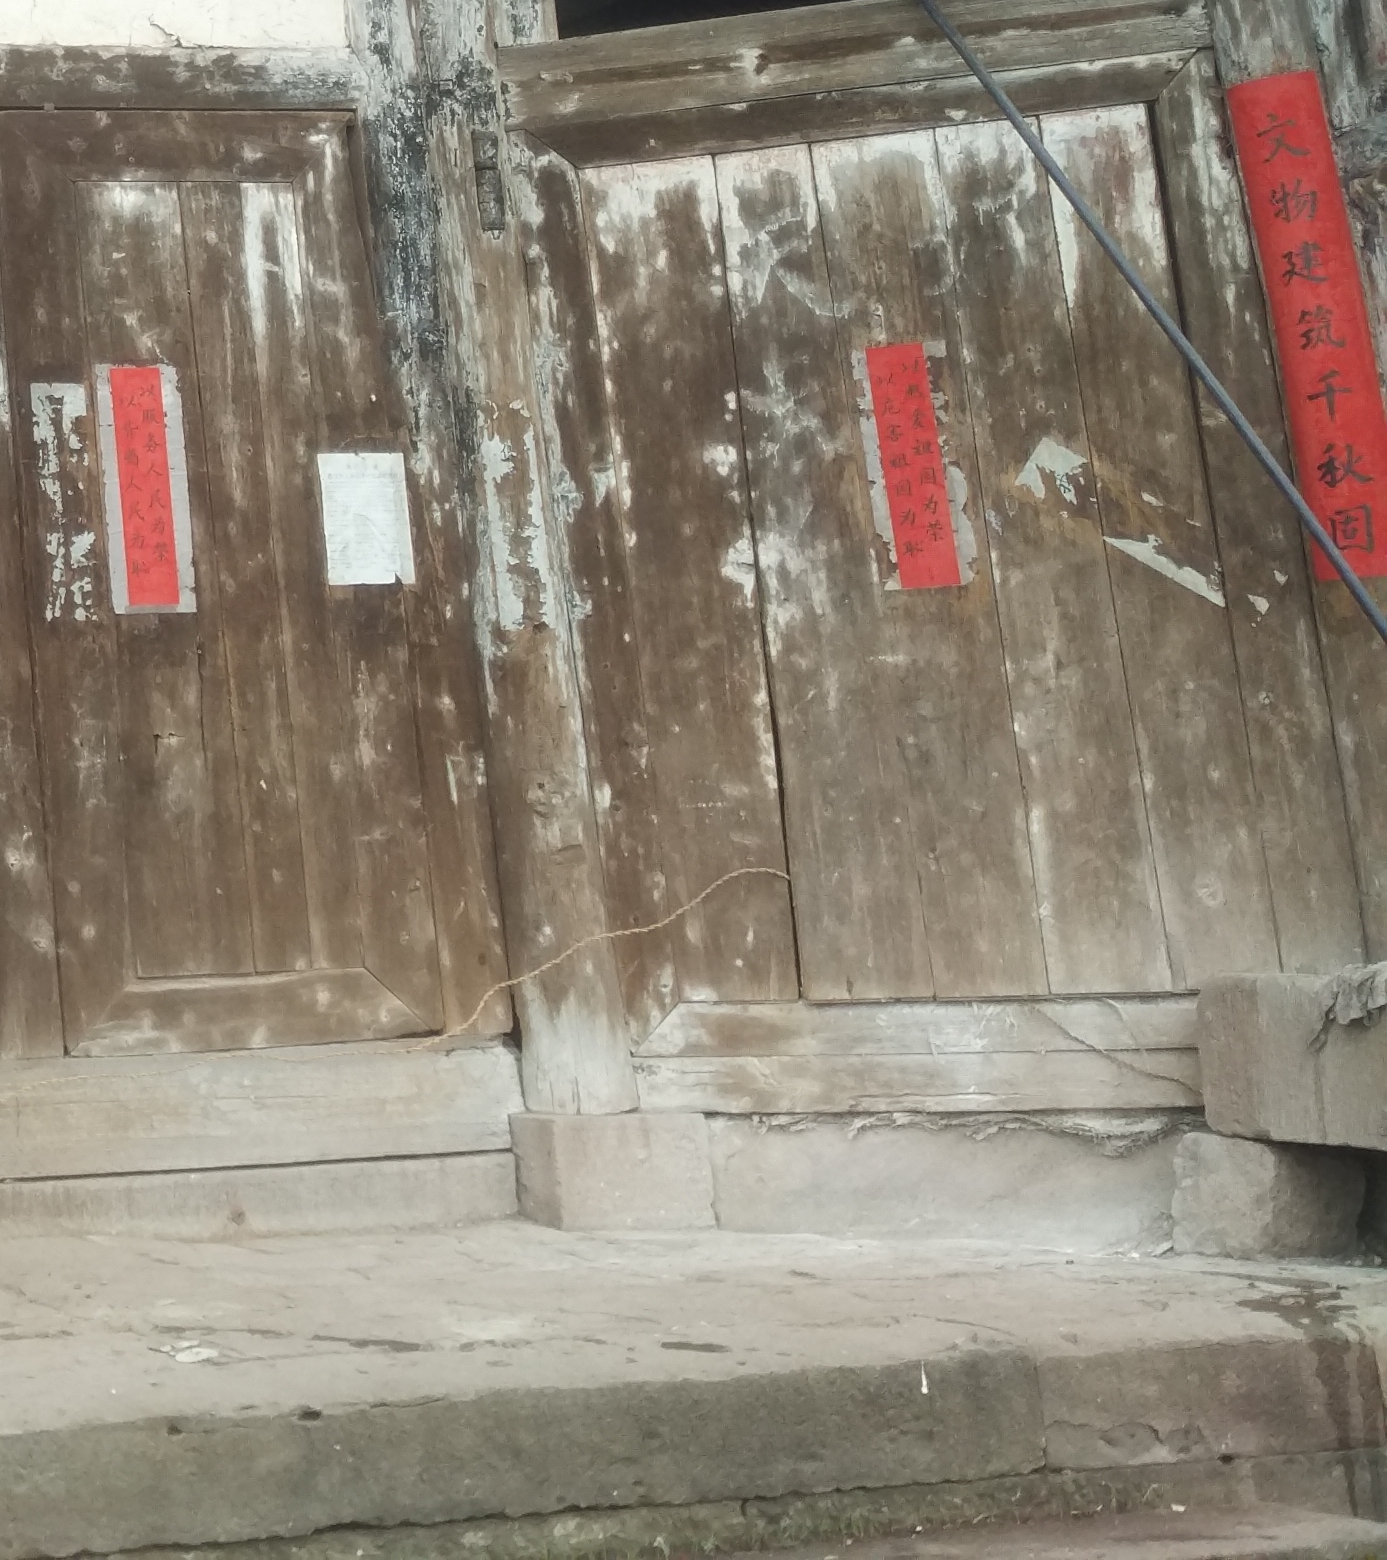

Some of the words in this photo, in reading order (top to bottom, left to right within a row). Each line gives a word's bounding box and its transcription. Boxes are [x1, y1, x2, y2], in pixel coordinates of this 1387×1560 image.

[1255, 113, 1376, 552] 文物建筑千秋固
